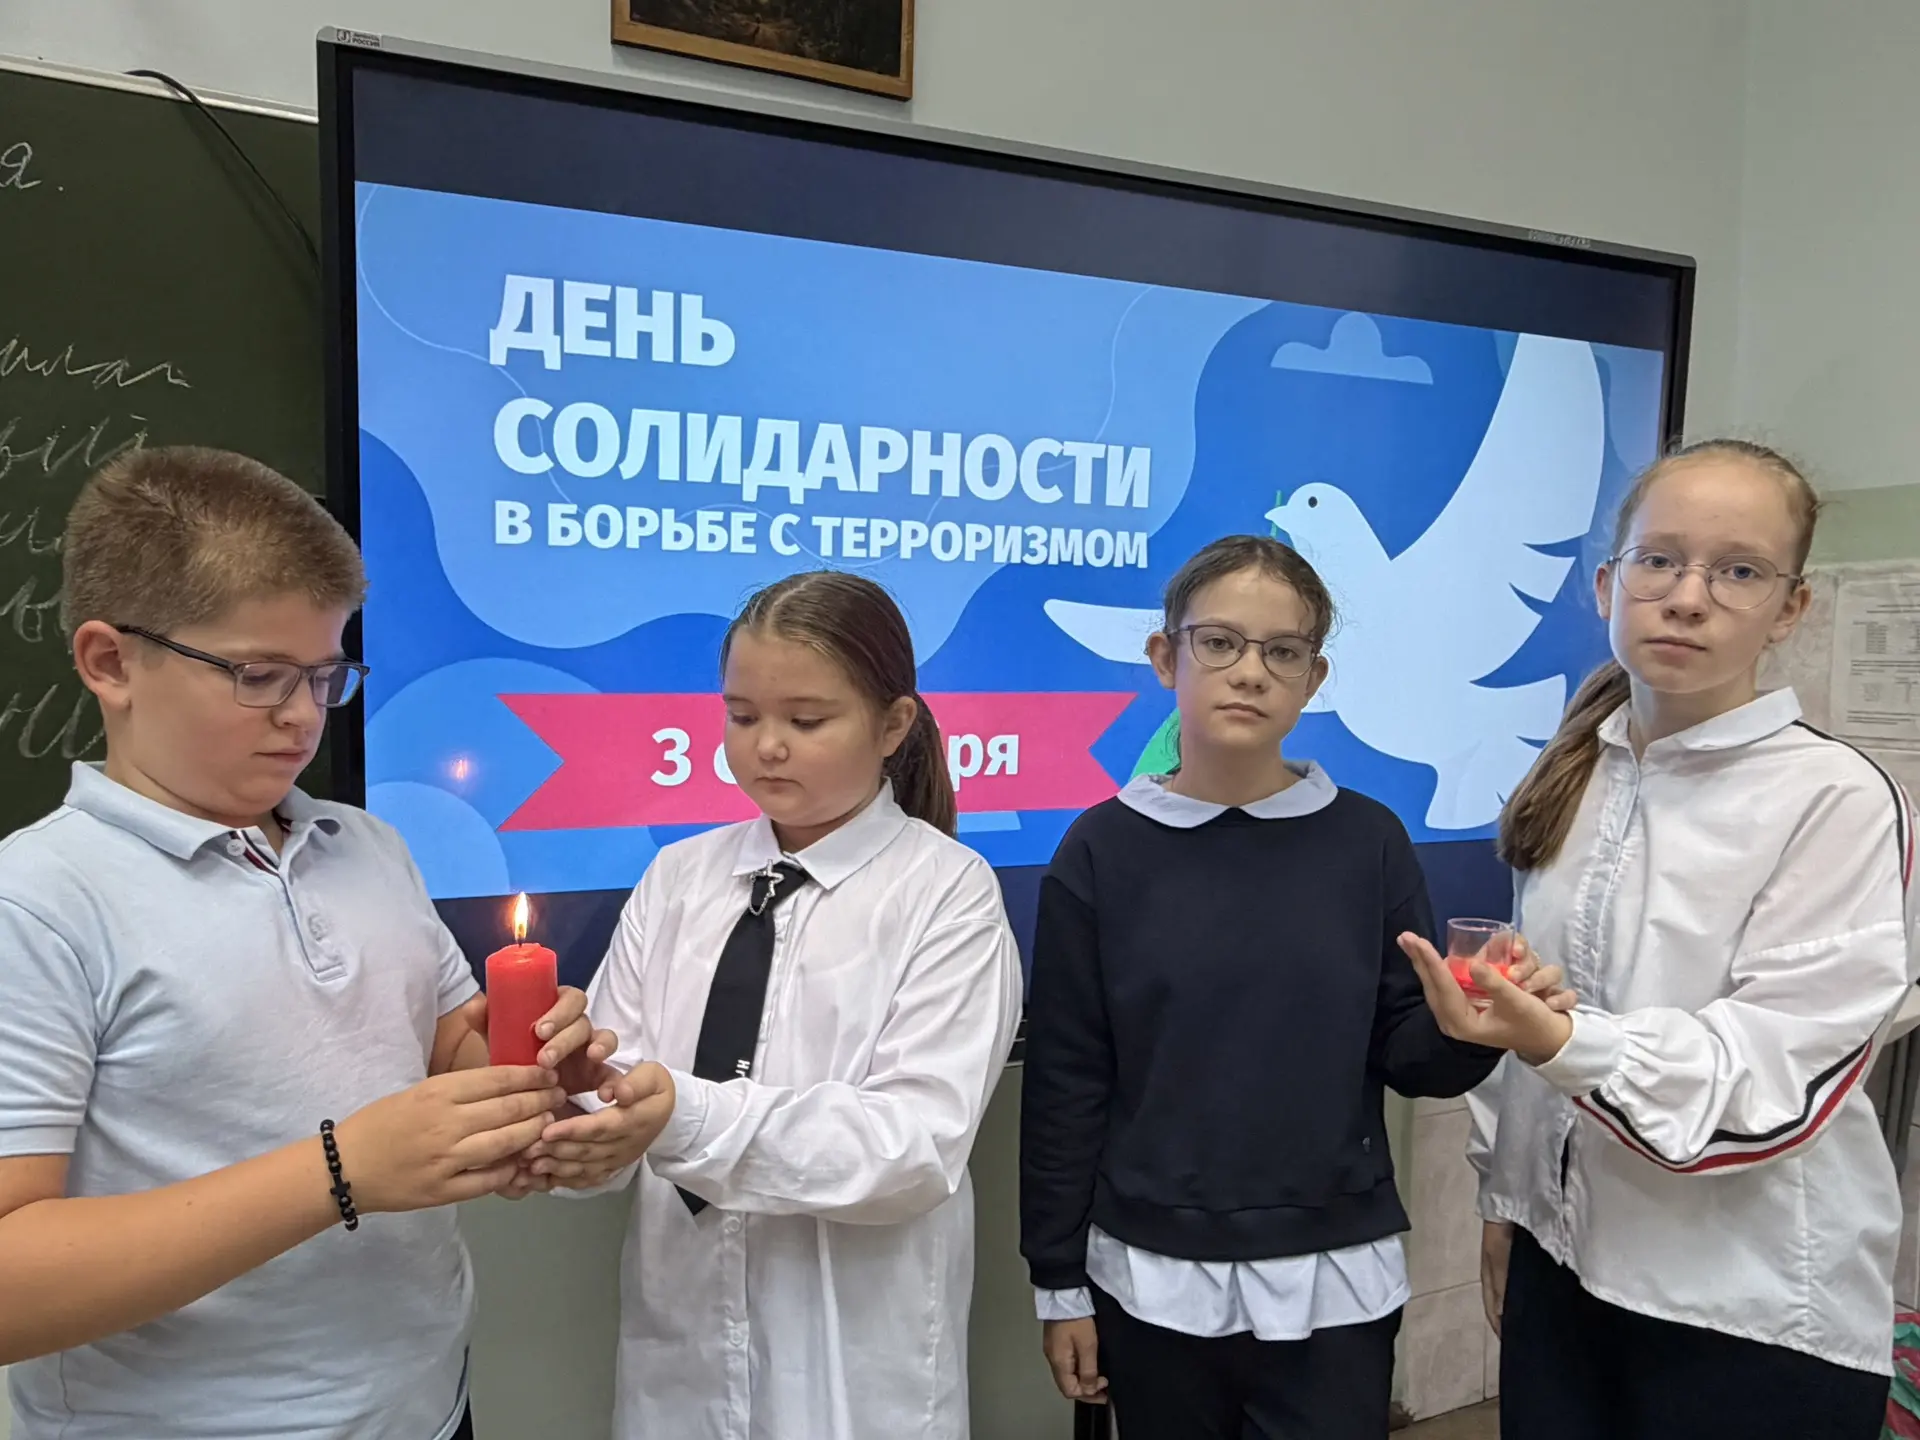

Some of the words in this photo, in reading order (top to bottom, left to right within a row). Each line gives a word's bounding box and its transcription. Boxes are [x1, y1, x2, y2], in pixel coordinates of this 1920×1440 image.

[489, 274, 736, 370] ДЕНЬ
[493, 397, 1151, 508] СОЛИДАРНОСТИ
[495, 500, 532, 544] В
[547, 503, 757, 553] БОРЬБЕ
[769, 513, 800, 555] С
[811, 516, 1148, 568] ТЕРРОРИЗМОМ
[650, 727, 692, 787] 3
